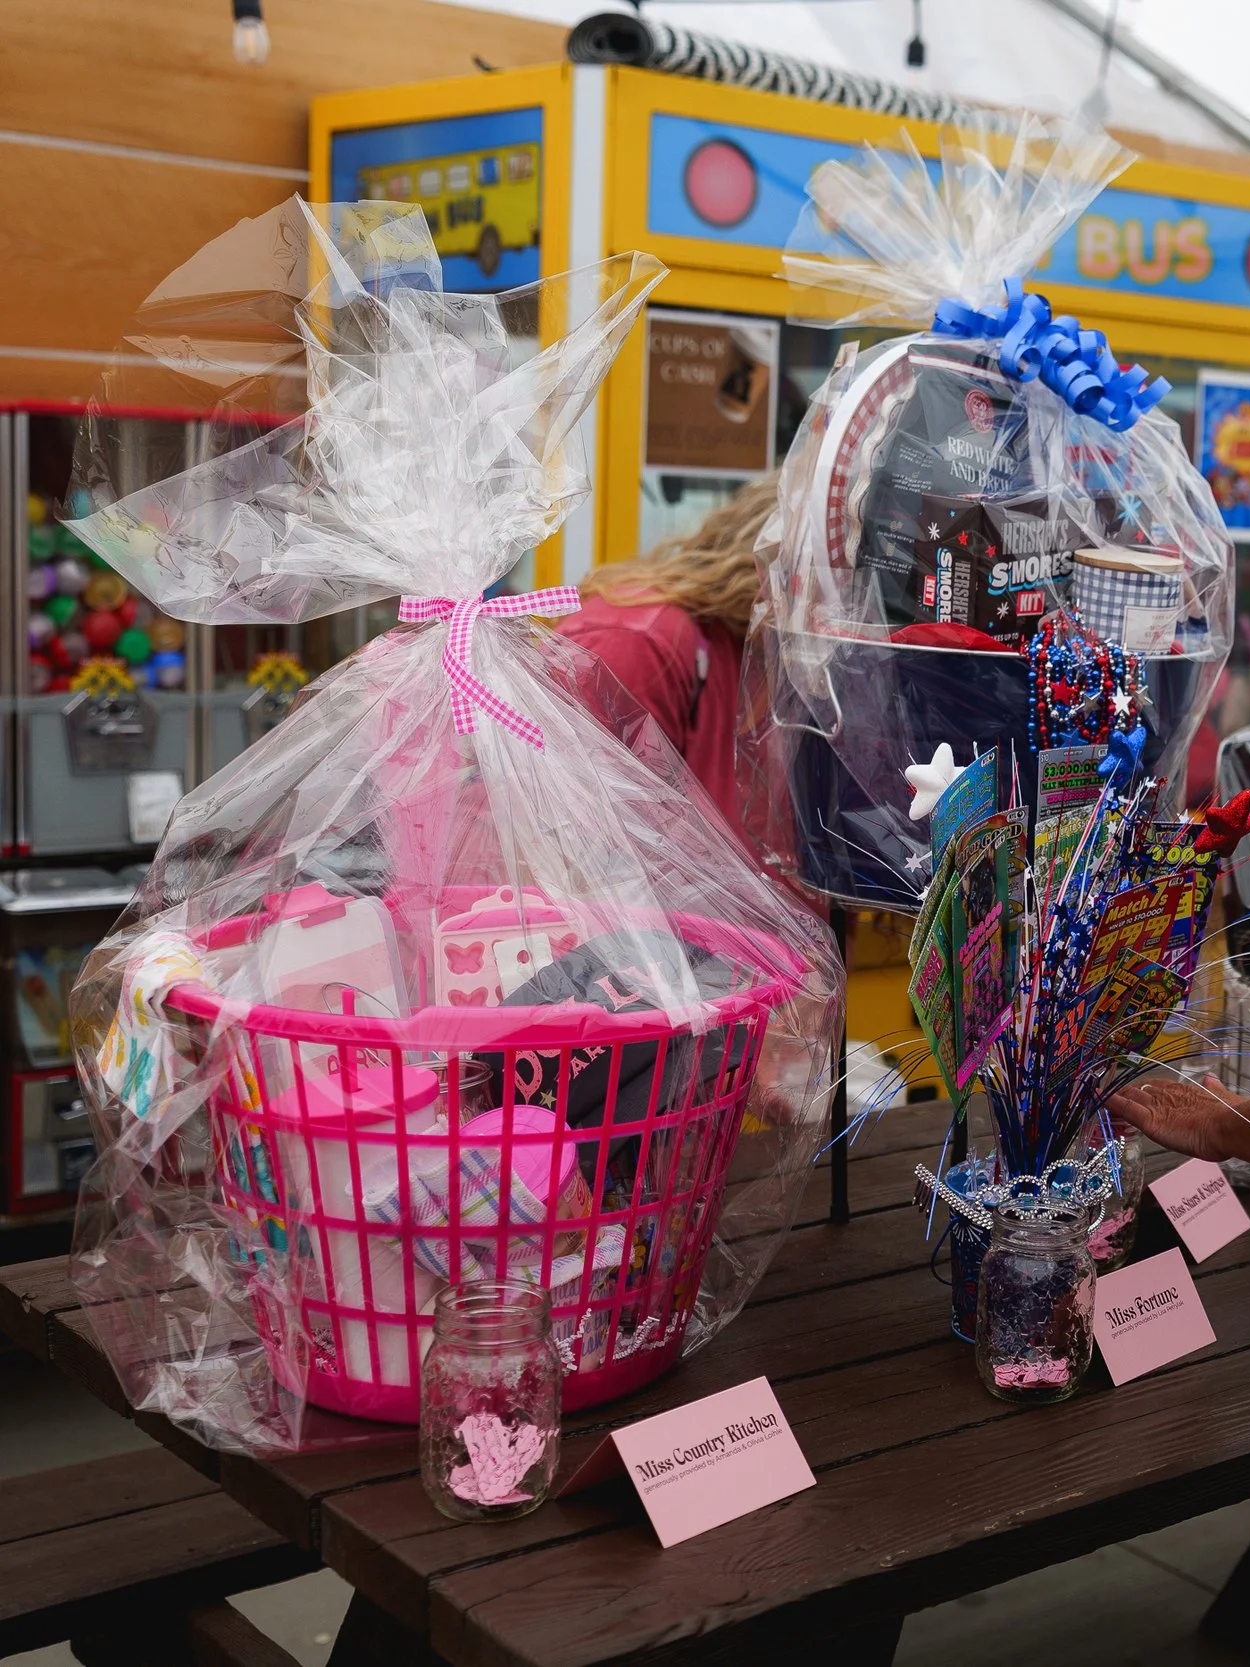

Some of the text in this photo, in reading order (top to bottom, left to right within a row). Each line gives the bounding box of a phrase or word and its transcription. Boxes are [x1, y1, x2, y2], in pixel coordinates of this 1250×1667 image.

[1077, 214, 1214, 284] BUS
[947, 436, 974, 459] RED
[950, 460, 976, 483] AND
[939, 550, 953, 624] S'MORE
[992, 550, 1074, 589] S'MORES
[926, 577, 936, 605] KIT
[952, 561, 971, 626] HERSHEY
[1020, 593, 1041, 612] KIT
[1043, 759, 1100, 779] $3,000,00
[1105, 894, 1150, 925] Match
[1166, 1205, 1186, 1222] Miss
[1105, 1286, 1179, 1329] Miss Fortune
[635, 1412, 779, 1483] Miss Country Kitchen
[643, 1474, 680, 1496] generously
[679, 1461, 707, 1480] provided
[707, 1457, 716, 1470] by
[715, 1445, 743, 1463] Amanda
[746, 1436, 765, 1451] Olivia
